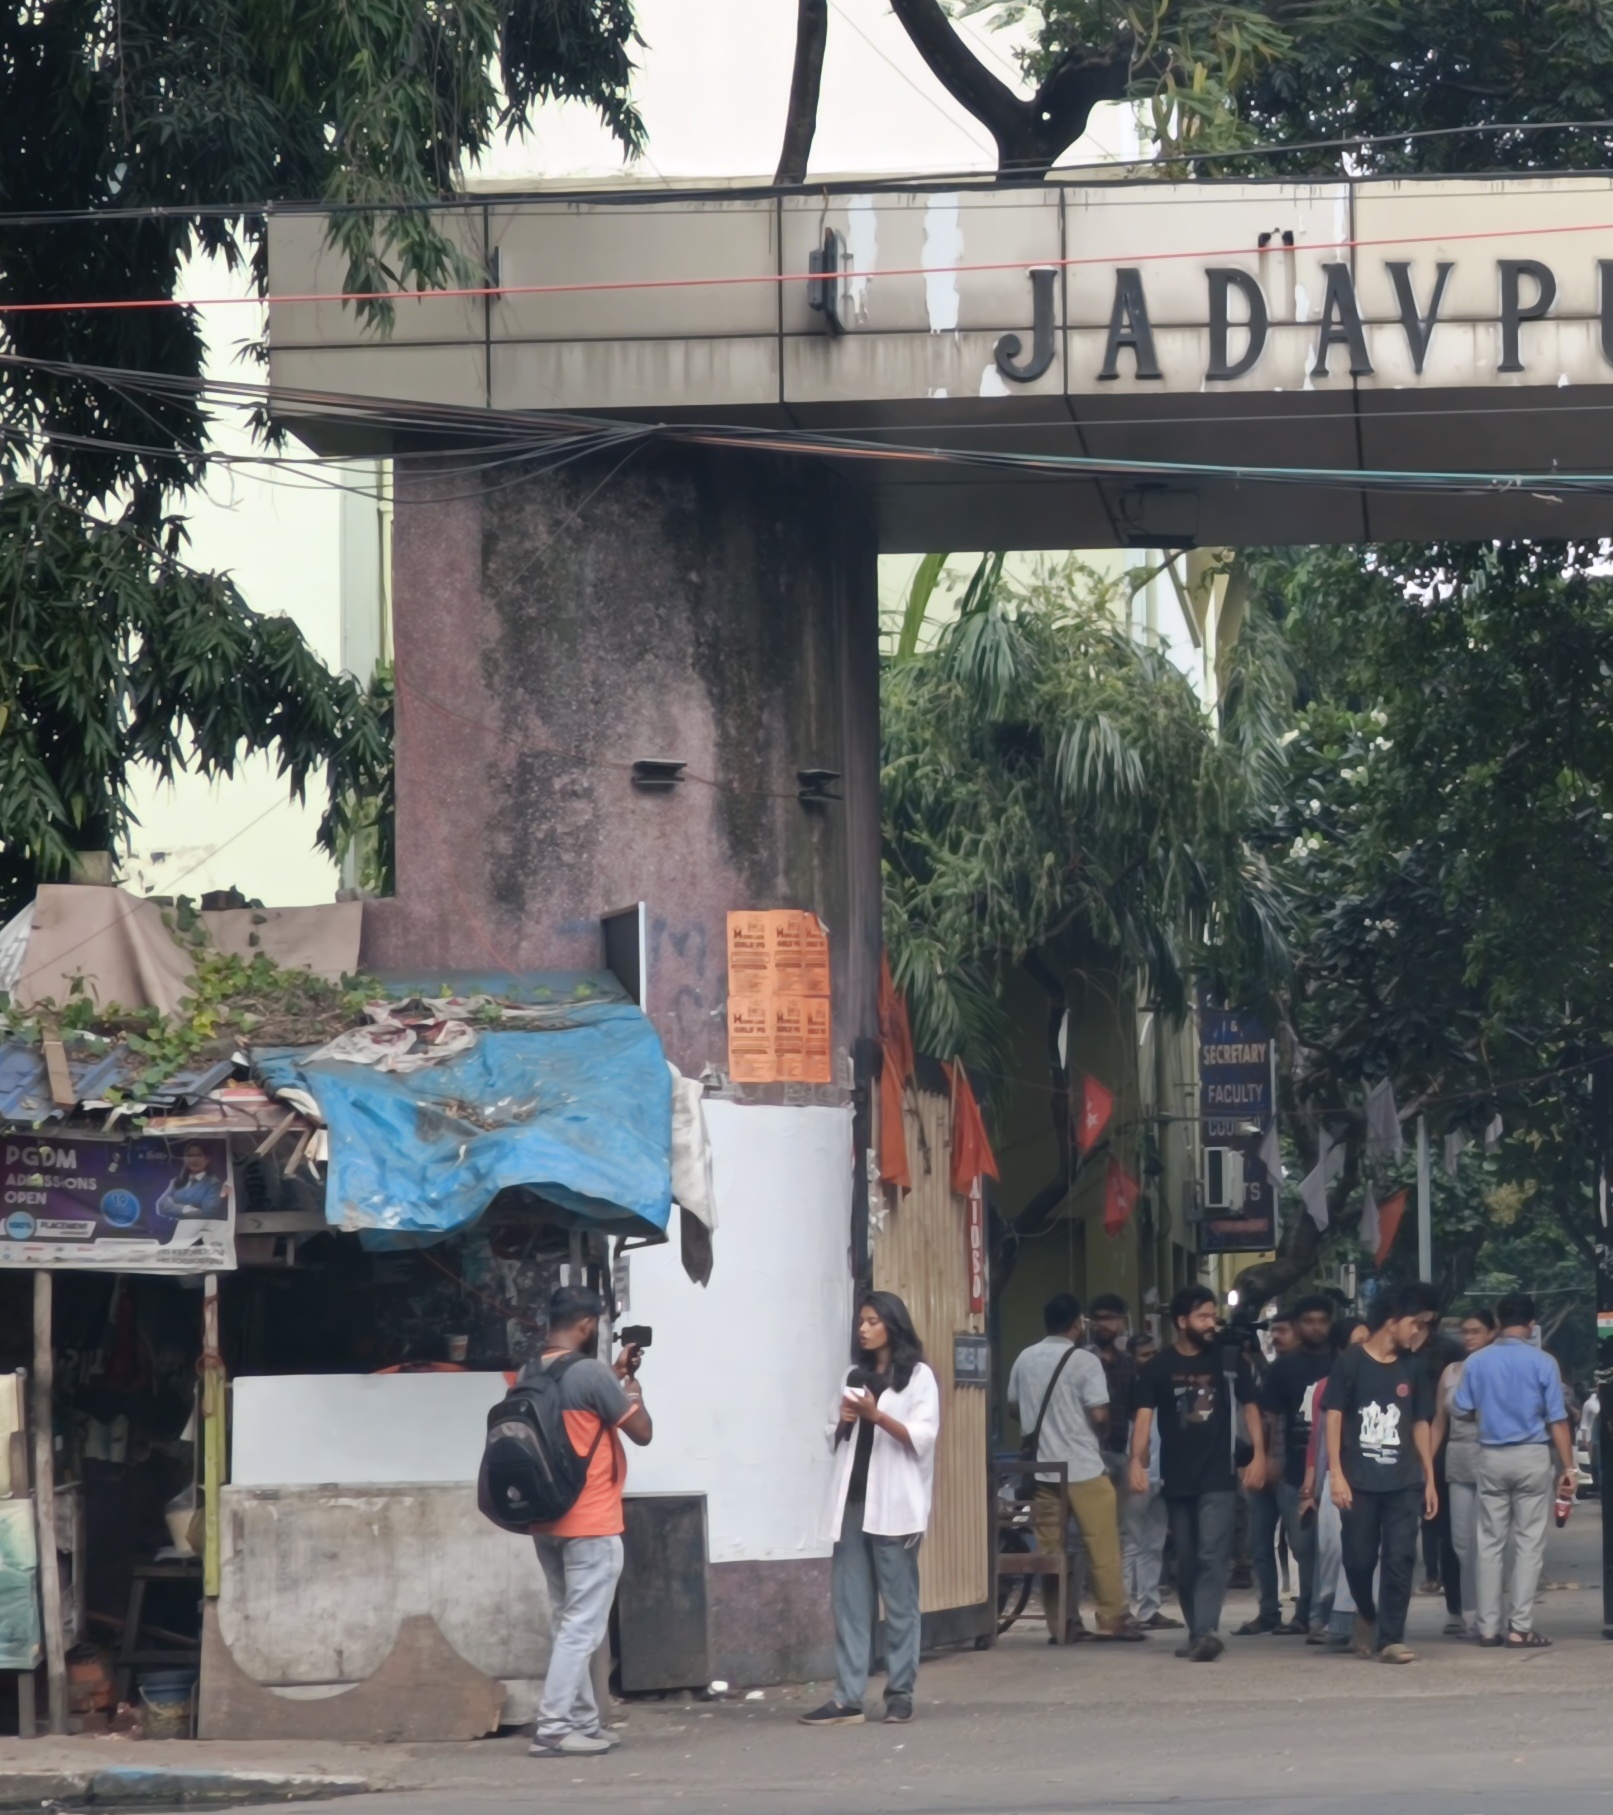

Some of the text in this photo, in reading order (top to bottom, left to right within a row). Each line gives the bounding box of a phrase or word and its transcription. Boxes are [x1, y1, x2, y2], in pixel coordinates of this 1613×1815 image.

[1203, 1043, 1267, 1066] SECRETARY
[1208, 1083, 1264, 1104] FACULTY
[5, 1144, 78, 1170] PGDM
[4, 1190, 48, 1205] OPEN
